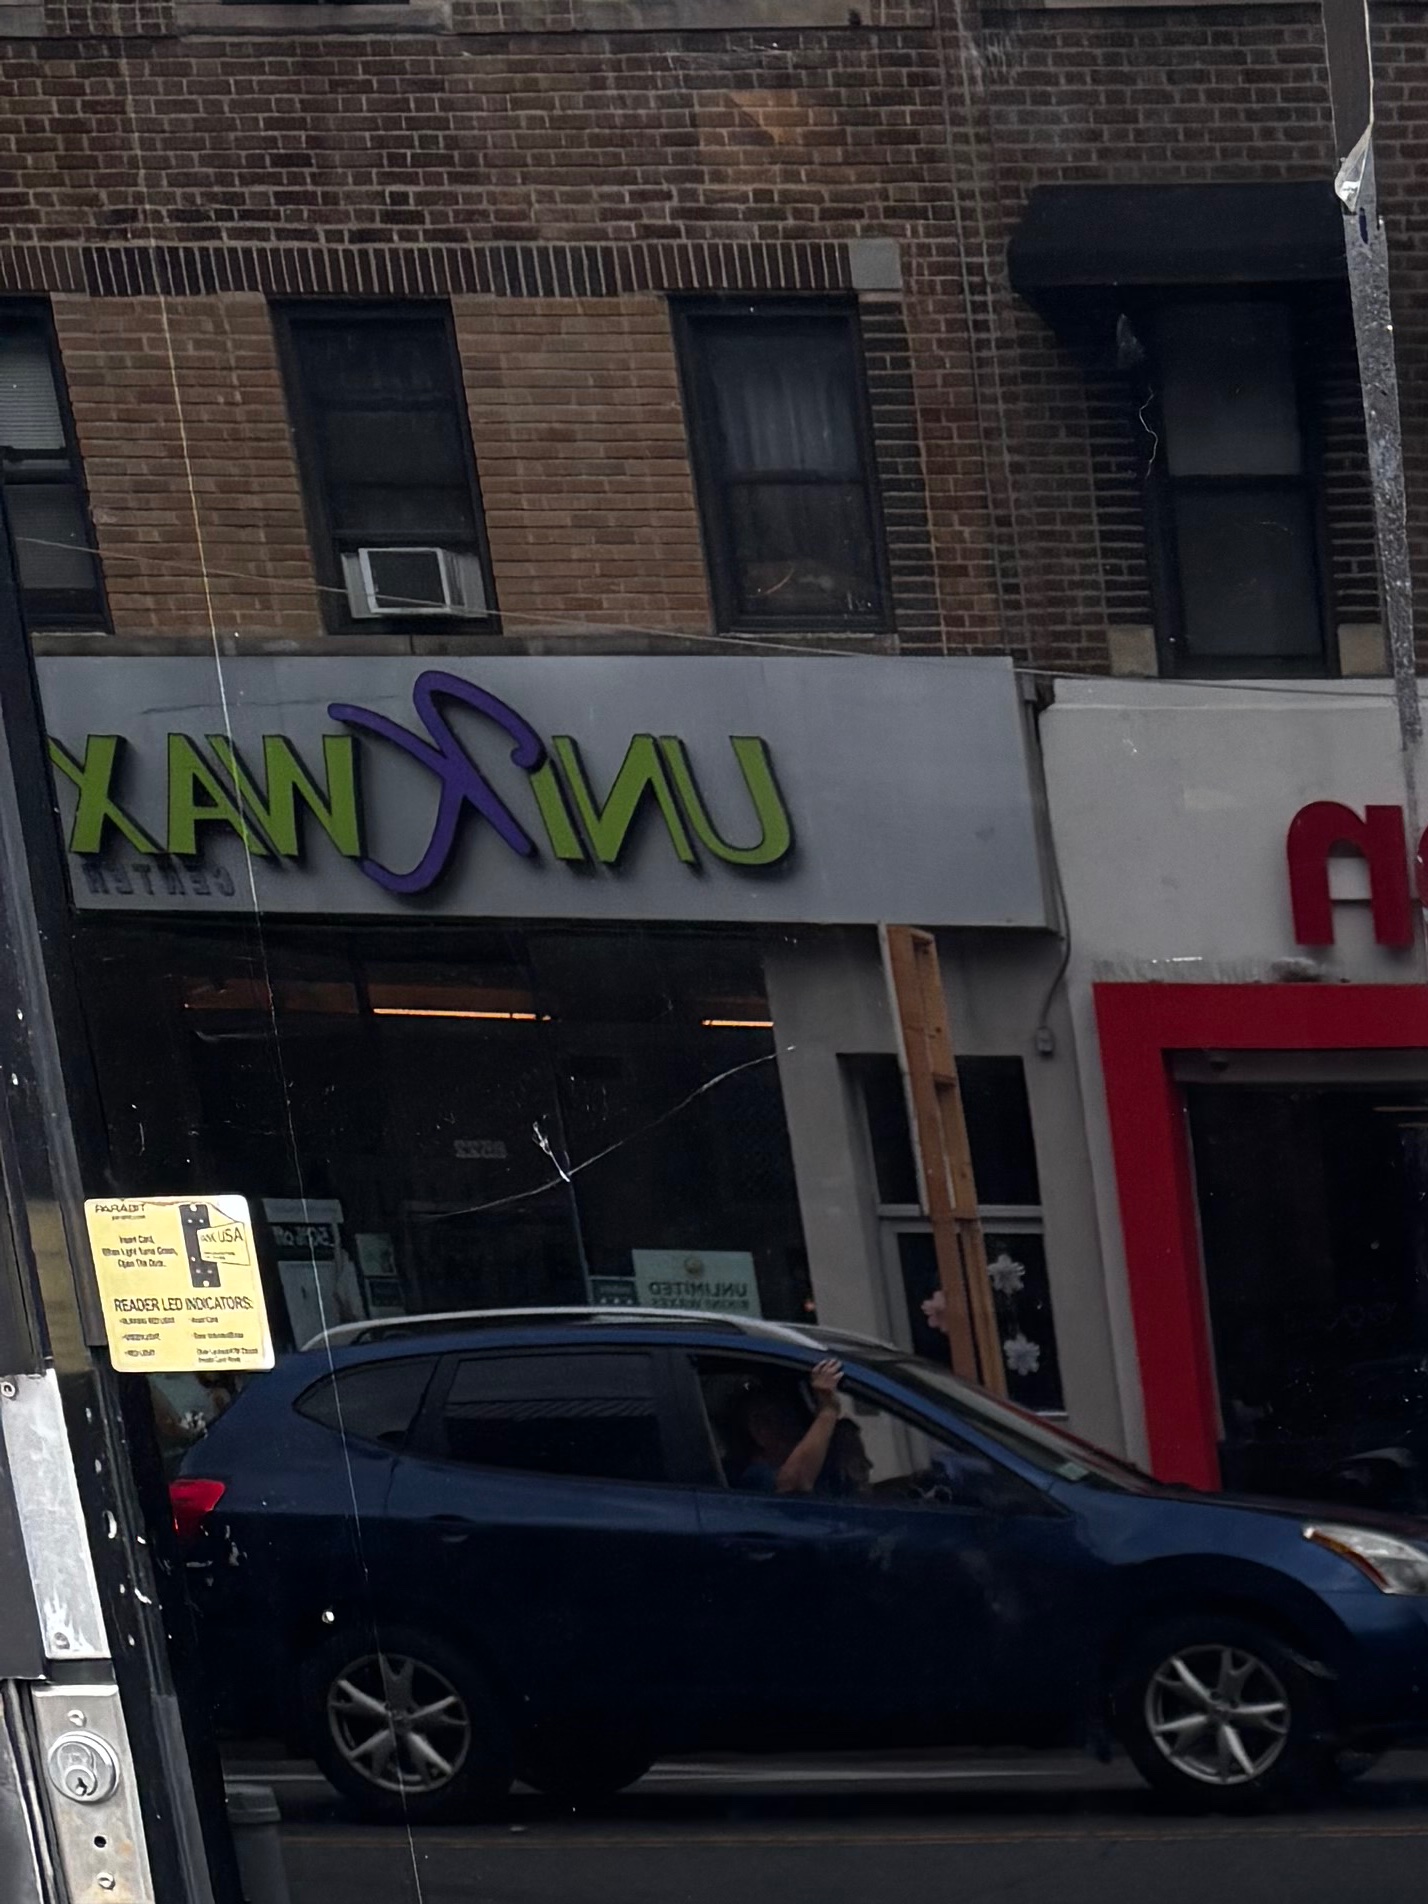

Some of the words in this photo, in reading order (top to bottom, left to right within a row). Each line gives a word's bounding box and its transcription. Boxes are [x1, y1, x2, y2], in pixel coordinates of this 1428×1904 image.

[217, 1226, 244, 1243] USA
[113, 1297, 161, 1312] READER
[161, 1297, 184, 1311] LED
